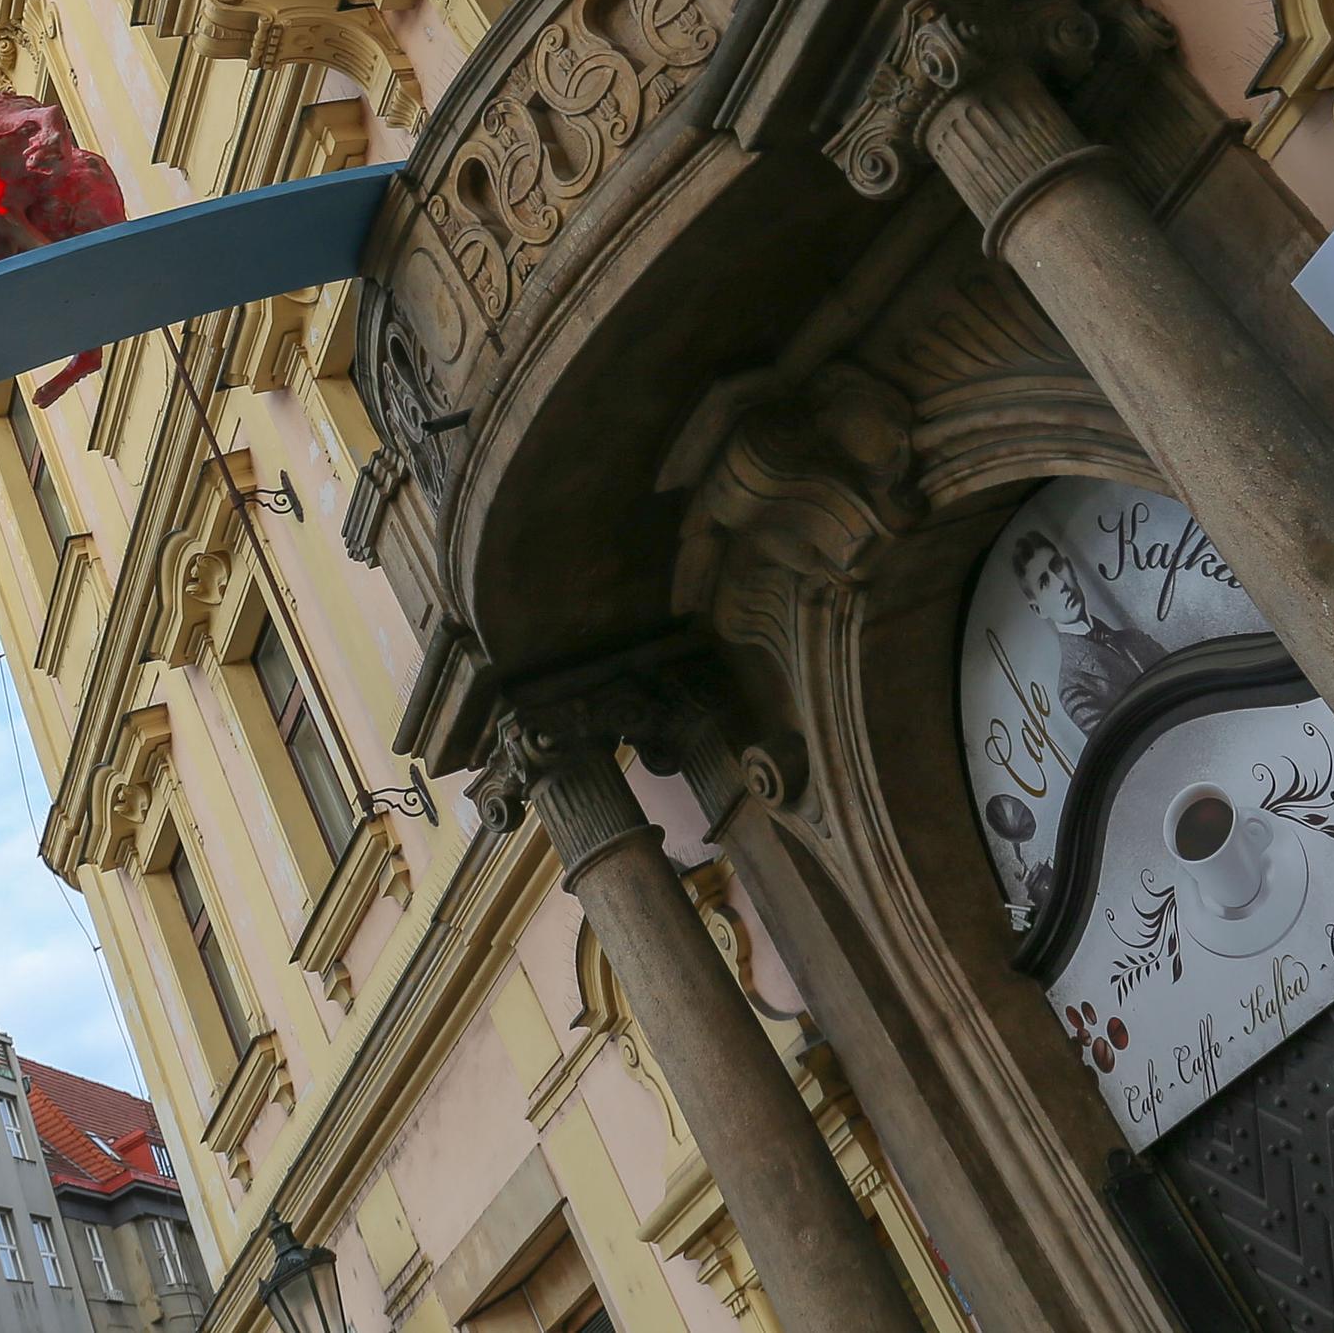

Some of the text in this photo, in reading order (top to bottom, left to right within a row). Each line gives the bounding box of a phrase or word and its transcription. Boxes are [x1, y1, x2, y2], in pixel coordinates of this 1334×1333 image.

[1124, 1059, 1163, 1138] Café
[1173, 1014, 1222, 1099] Caffe
[1240, 955, 1309, 1040] Kafka
